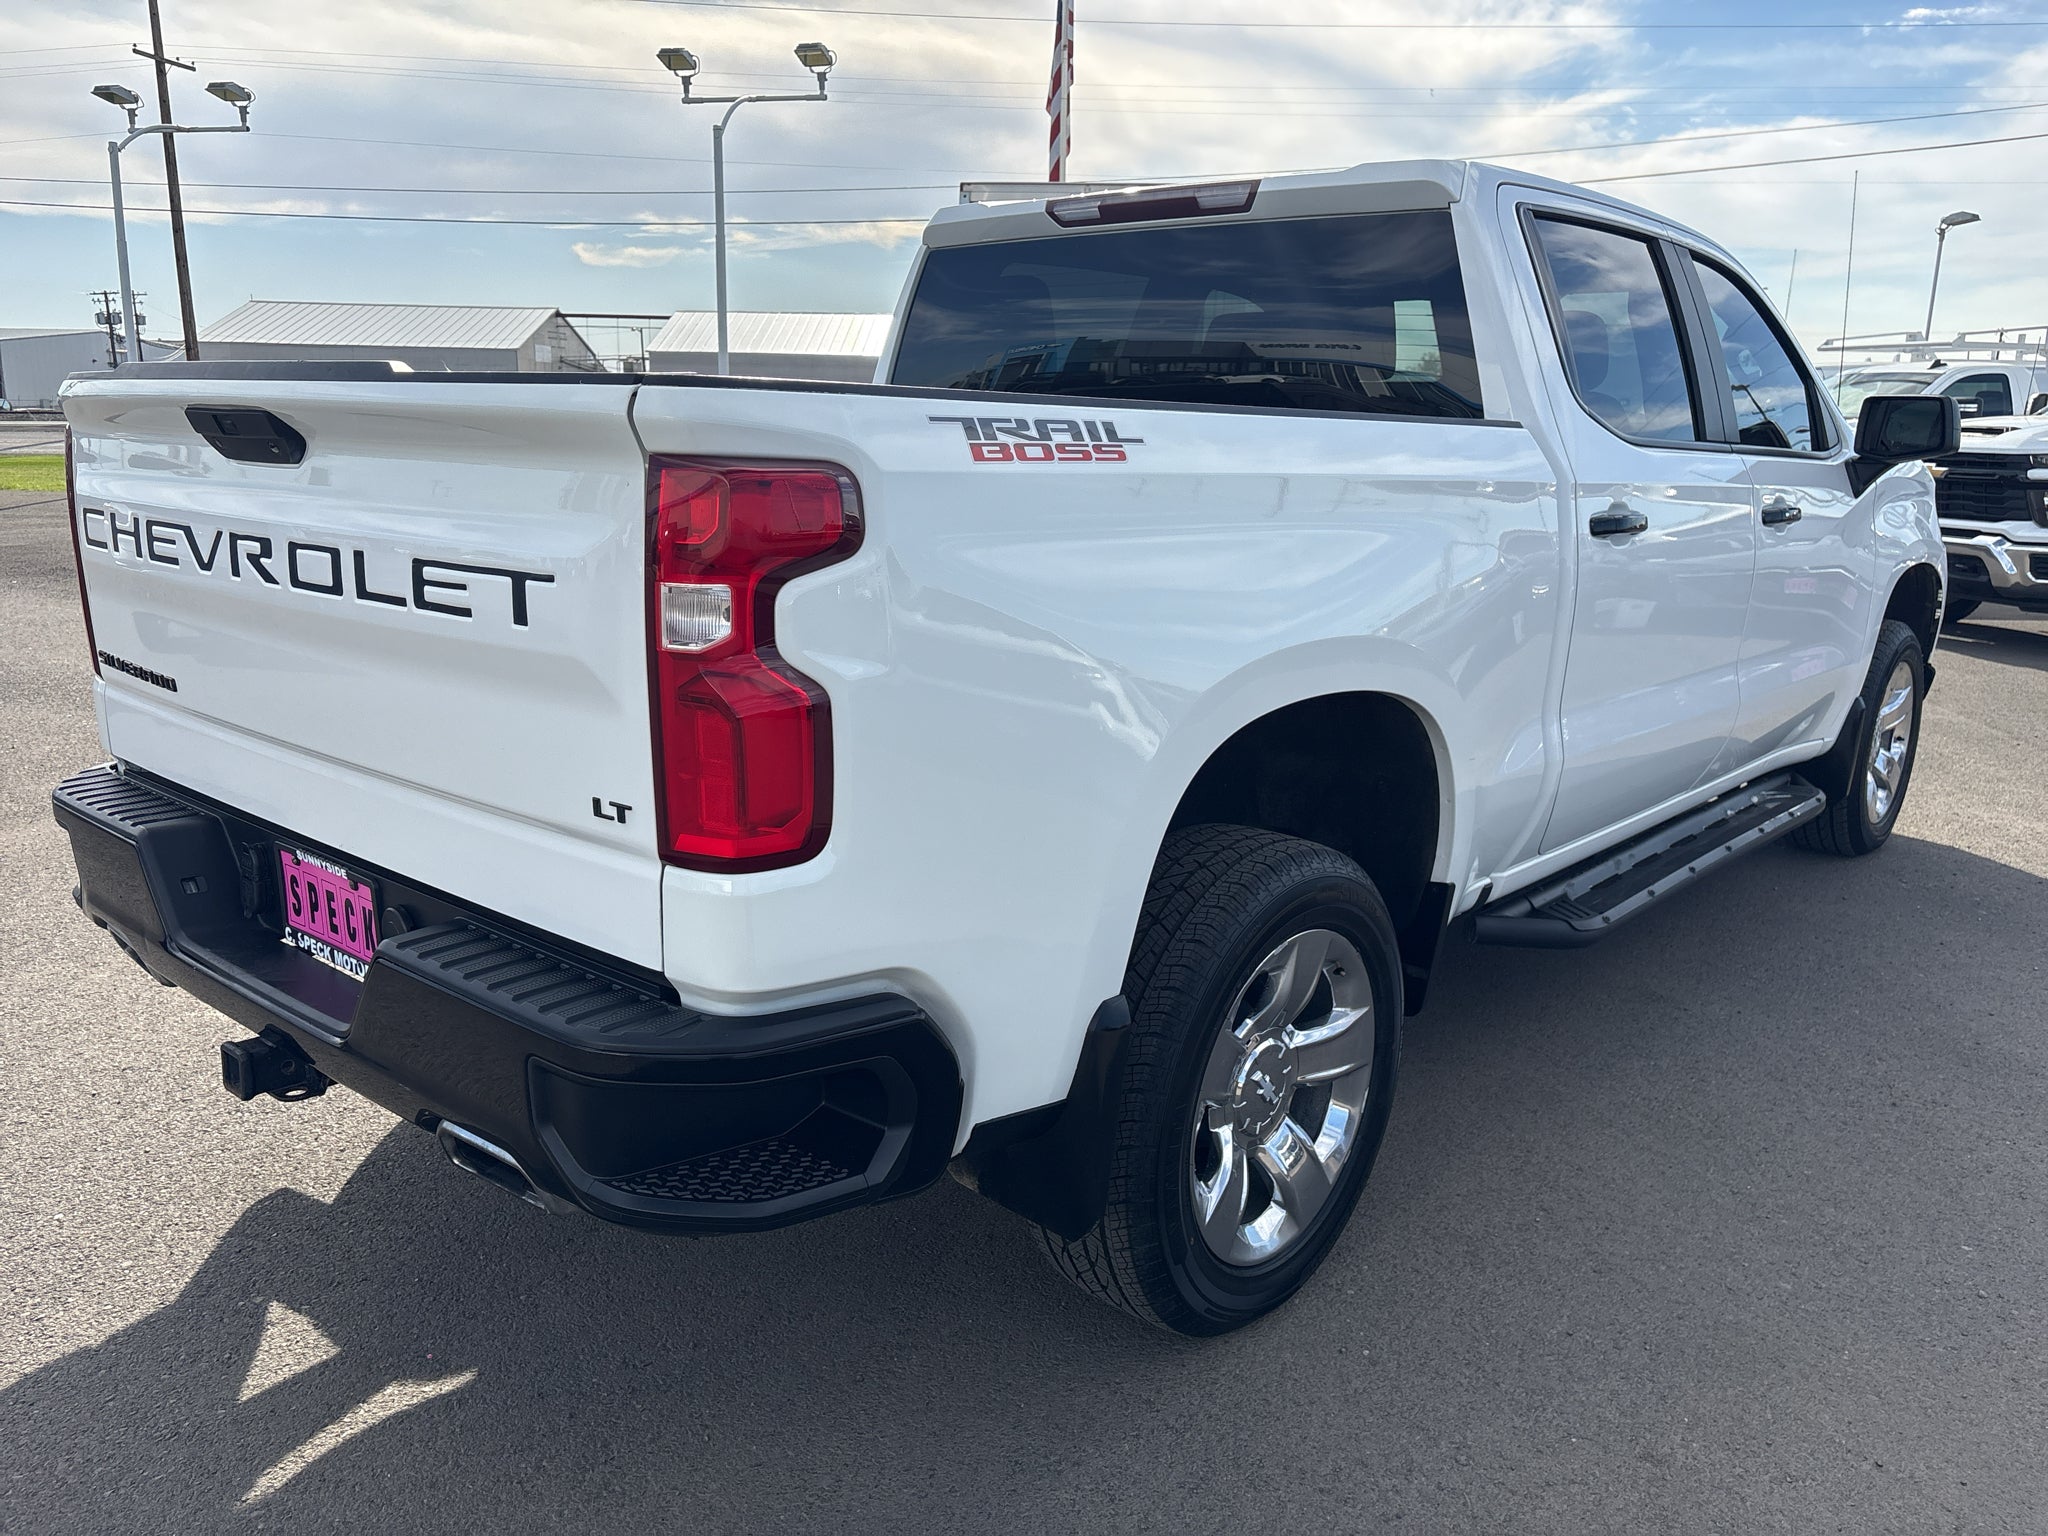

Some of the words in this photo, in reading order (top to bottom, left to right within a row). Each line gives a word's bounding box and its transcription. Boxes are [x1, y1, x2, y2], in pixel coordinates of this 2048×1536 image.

[928, 415, 1145, 444] TRAIL
[968, 441, 1128, 463] BOSS
[82, 507, 556, 627] CHEVROLET
[98, 649, 178, 692] SILVERADO
[592, 796, 633, 824] LT
[296, 850, 348, 879] SUNNYSIDE
[289, 873, 378, 953] SPECK
[284, 926, 296, 943] C.
[297, 932, 331, 961] SPECK
